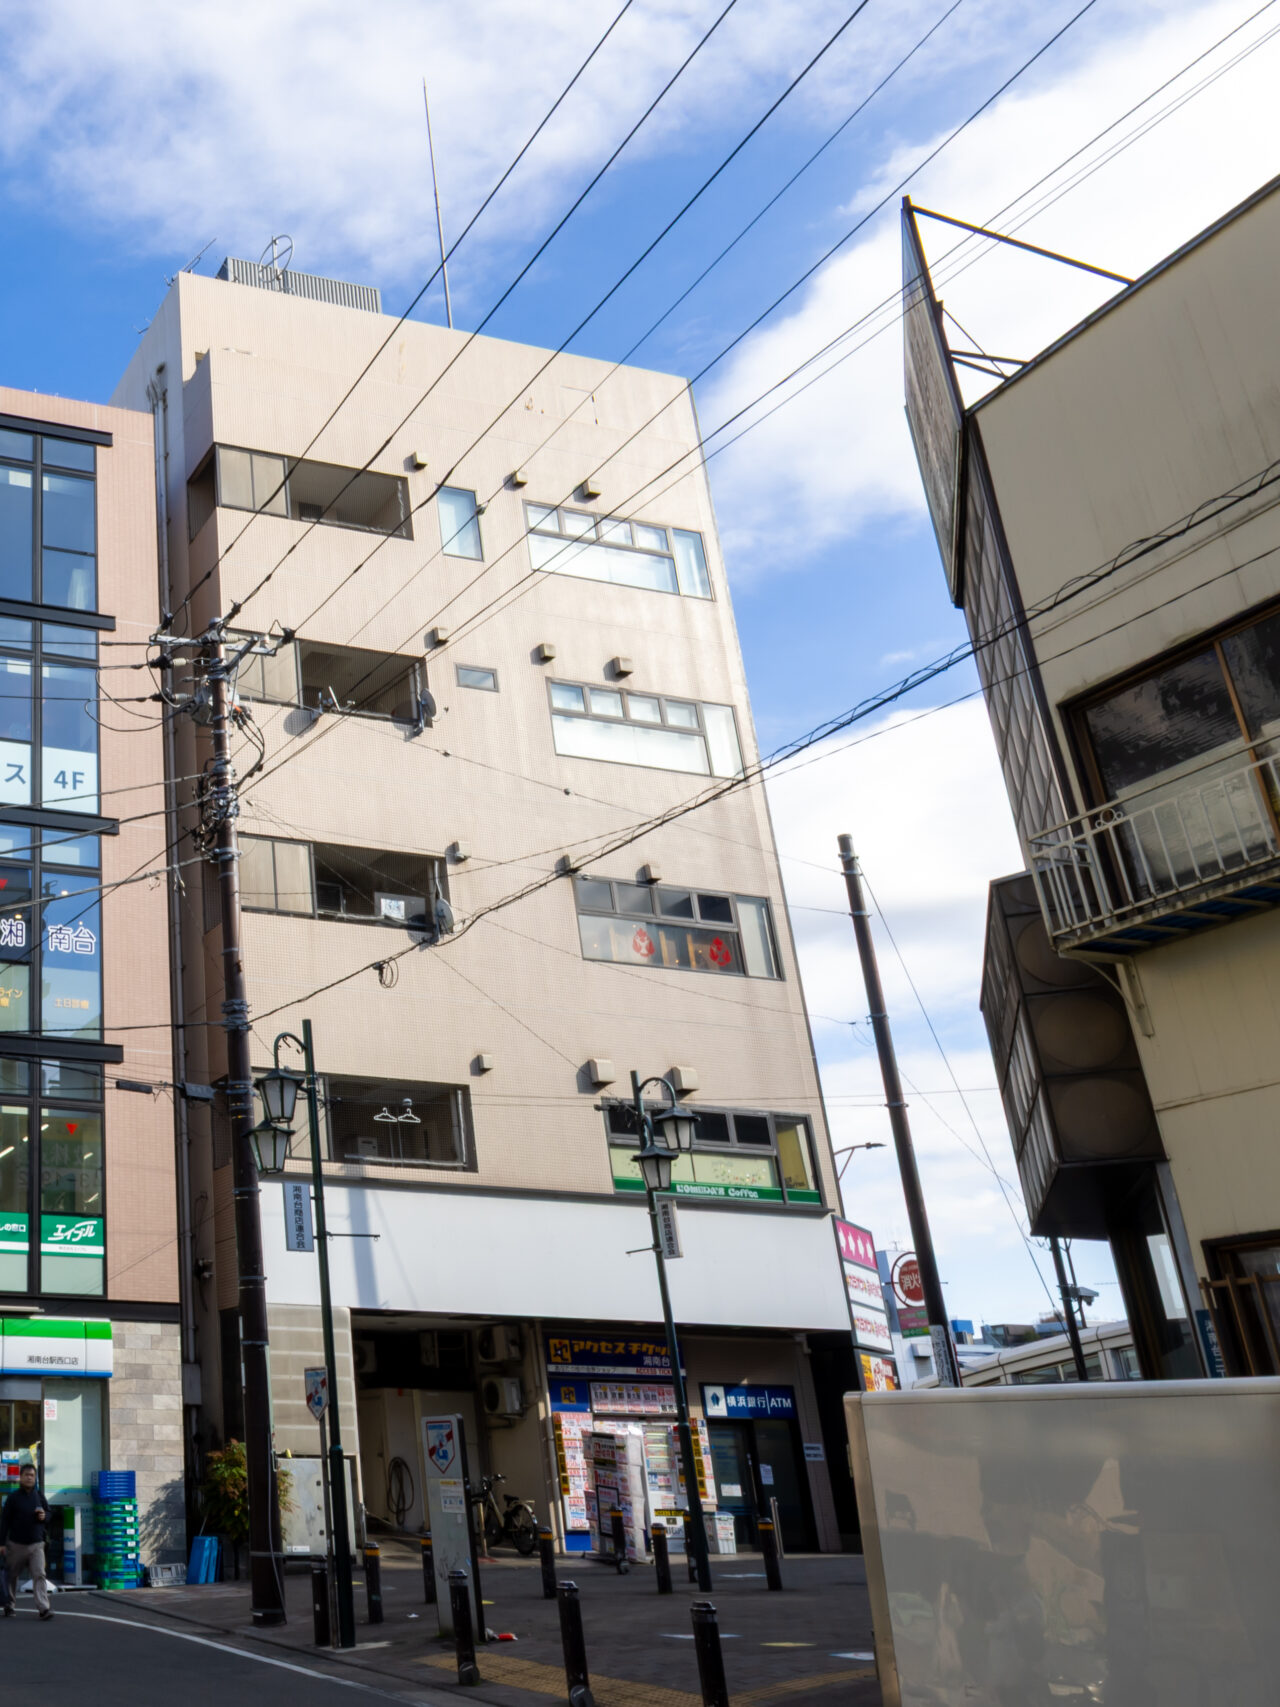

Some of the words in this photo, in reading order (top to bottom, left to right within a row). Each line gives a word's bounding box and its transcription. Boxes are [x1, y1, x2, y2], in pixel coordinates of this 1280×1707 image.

[53, 769, 86, 791] 4F
[48, 1220, 98, 1242] エイブル
[902, 1272, 923, 1291] 消火
[571, 1340, 671, 1356] アクセスチケッ
[26, 1354, 79, 1366] 湘南台駅西口店
[726, 1395, 766, 1409] 横浜銀行
[770, 1397, 792, 1409] ATM
